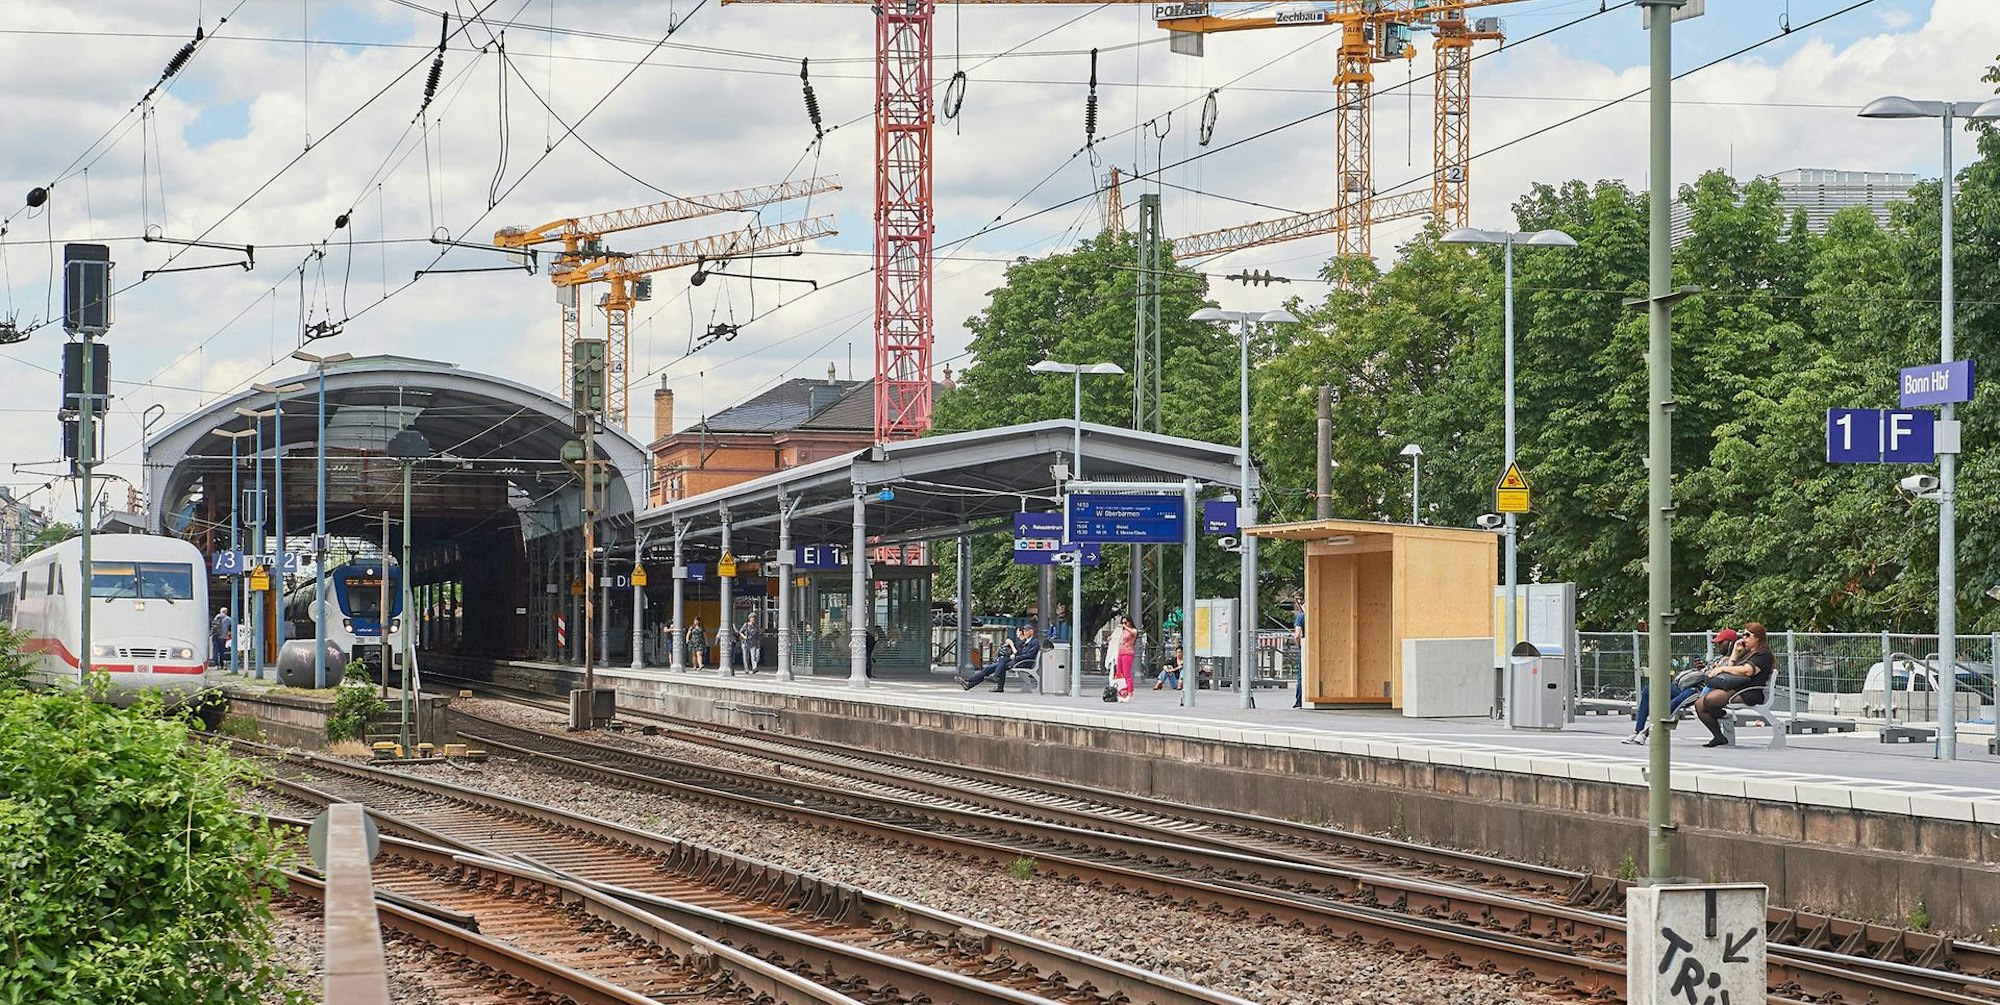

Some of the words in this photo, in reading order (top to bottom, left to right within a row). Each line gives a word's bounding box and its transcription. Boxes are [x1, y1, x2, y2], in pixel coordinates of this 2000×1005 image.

[1276, 12, 1316, 21] Zechbau
[1452, 167, 1460, 179] 2
[615, 363, 622, 371] 4
[1905, 375, 1929, 394] Bonn
[1931, 369, 1949, 392] Hbf
[1836, 413, 1851, 450] 1
[1890, 413, 1913, 451] F
[224, 552, 235, 568] 3
[284, 553, 295, 568] 2
[804, 547, 815, 563] E
[832, 549, 839, 564] 1
[617, 575, 626, 587] D
